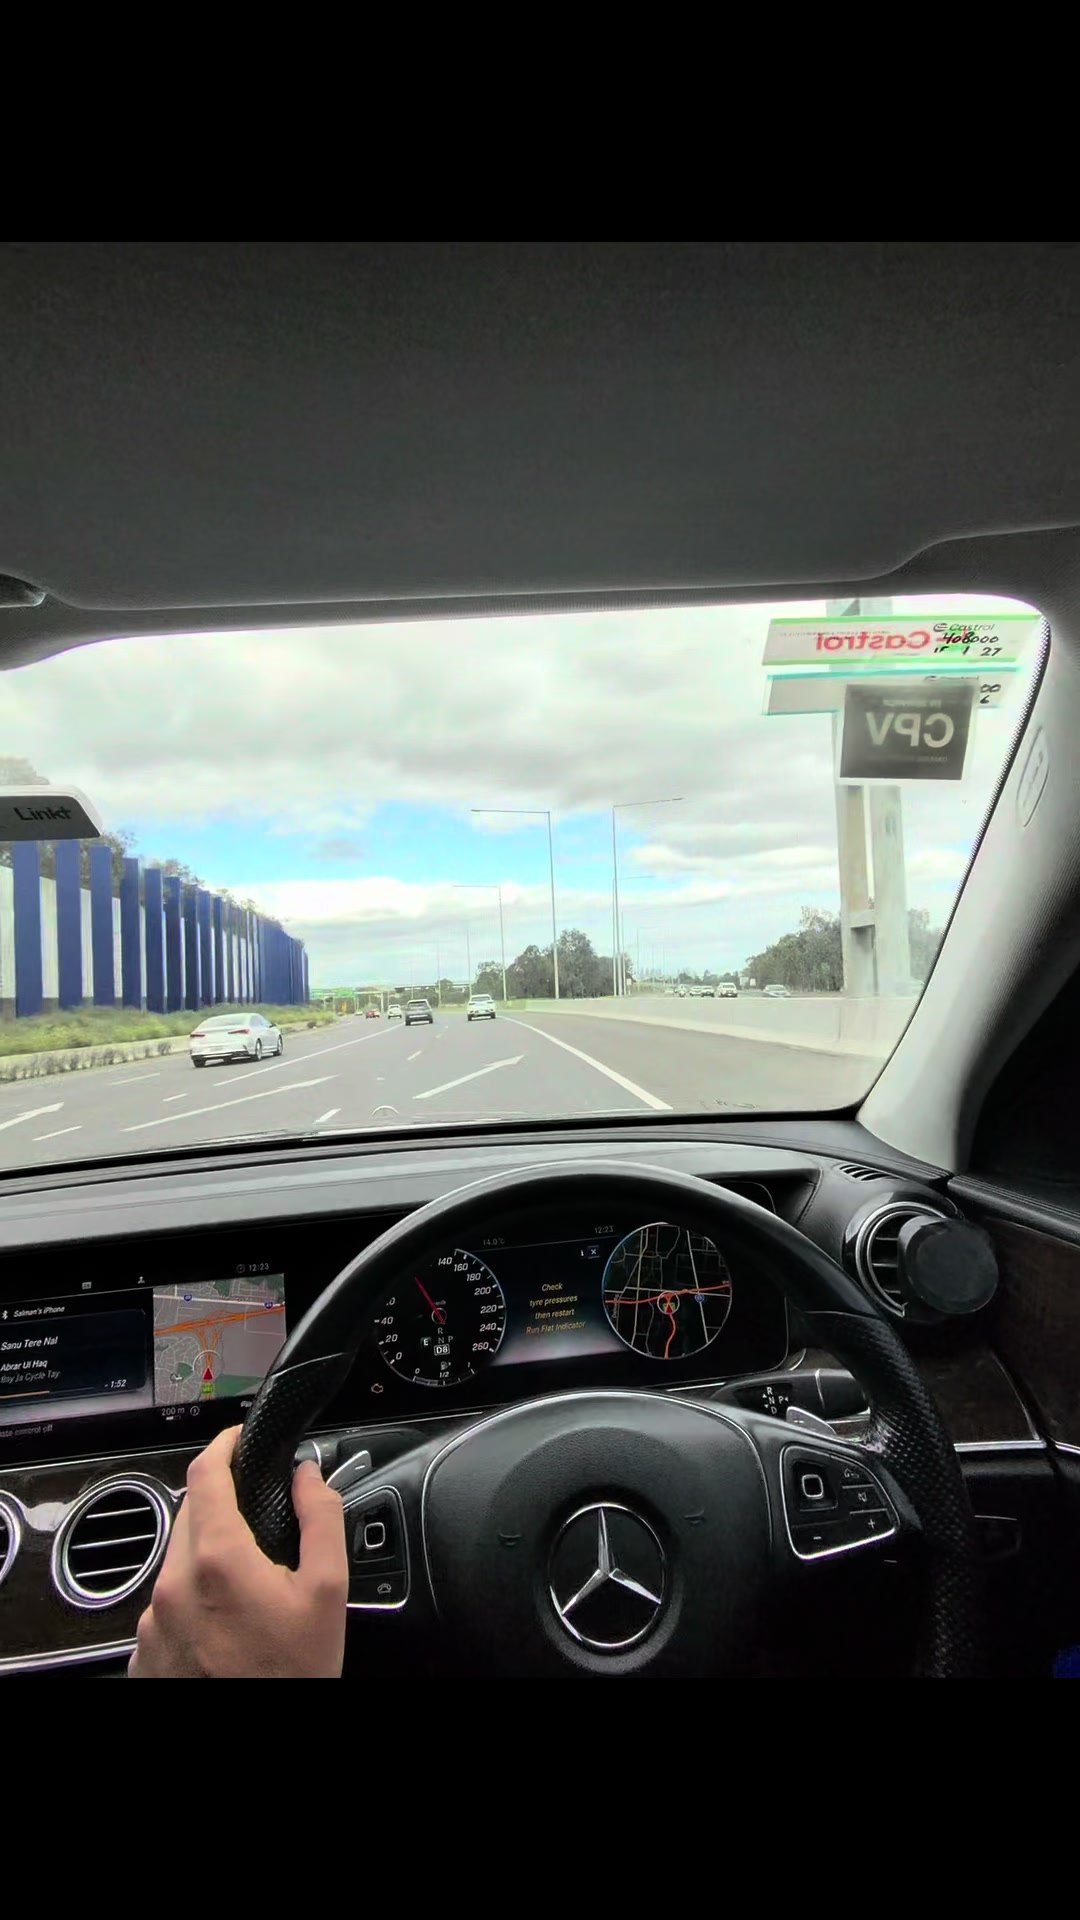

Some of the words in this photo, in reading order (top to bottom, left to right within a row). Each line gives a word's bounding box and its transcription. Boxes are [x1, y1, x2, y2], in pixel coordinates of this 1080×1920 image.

[943, 631, 999, 644] 408000
[980, 647, 1002, 656] 27
[14, 807, 71, 820] Linkt
[594, 1225, 614, 1234] 12:23
[438, 1256, 453, 1266] 140
[249, 1263, 270, 1271] 12:23
[454, 1263, 469, 1272] 160
[466, 1272, 481, 1281] 180
[474, 1286, 491, 1296] 200
[541, 1283, 563, 1292] Check
[529, 1299, 544, 1309] tyre
[544, 1294, 578, 1306] pressures
[14, 1308, 43, 1318] Salman's
[43, 1306, 65, 1314] iPhone
[480, 1304, 497, 1314] 220
[535, 1312, 551, 1320] then
[551, 1308, 575, 1317] restart
[380, 1316, 394, 1325] 40
[437, 1327, 444, 1335] R
[479, 1323, 497, 1332] 240
[526, 1326, 540, 1334] Run
[541, 1323, 555, 1333] Flat
[556, 1320, 586, 1331] Indicator
[385, 1333, 398, 1343] 20
[423, 1338, 429, 1346] E
[448, 1335, 454, 1343] P
[0, 1341, 22, 1351] Sanu
[24, 1339, 42, 1348] Tere
[472, 1341, 489, 1351] 260
[436, 1346, 448, 1354] D8
[395, 1351, 403, 1360] 0
[0, 1363, 22, 1372] Abrar
[32, 1360, 48, 1369] Haq
[24, 1371, 46, 1382] Cycle
[47, 1369, 61, 1380] Tay
[766, 1386, 773, 1395] R
[768, 1396, 776, 1405] N
[778, 1395, 784, 1404] P
[161, 1408, 176, 1416] 200
[770, 1406, 778, 1415] D
[42, 1424, 53, 1433] off
